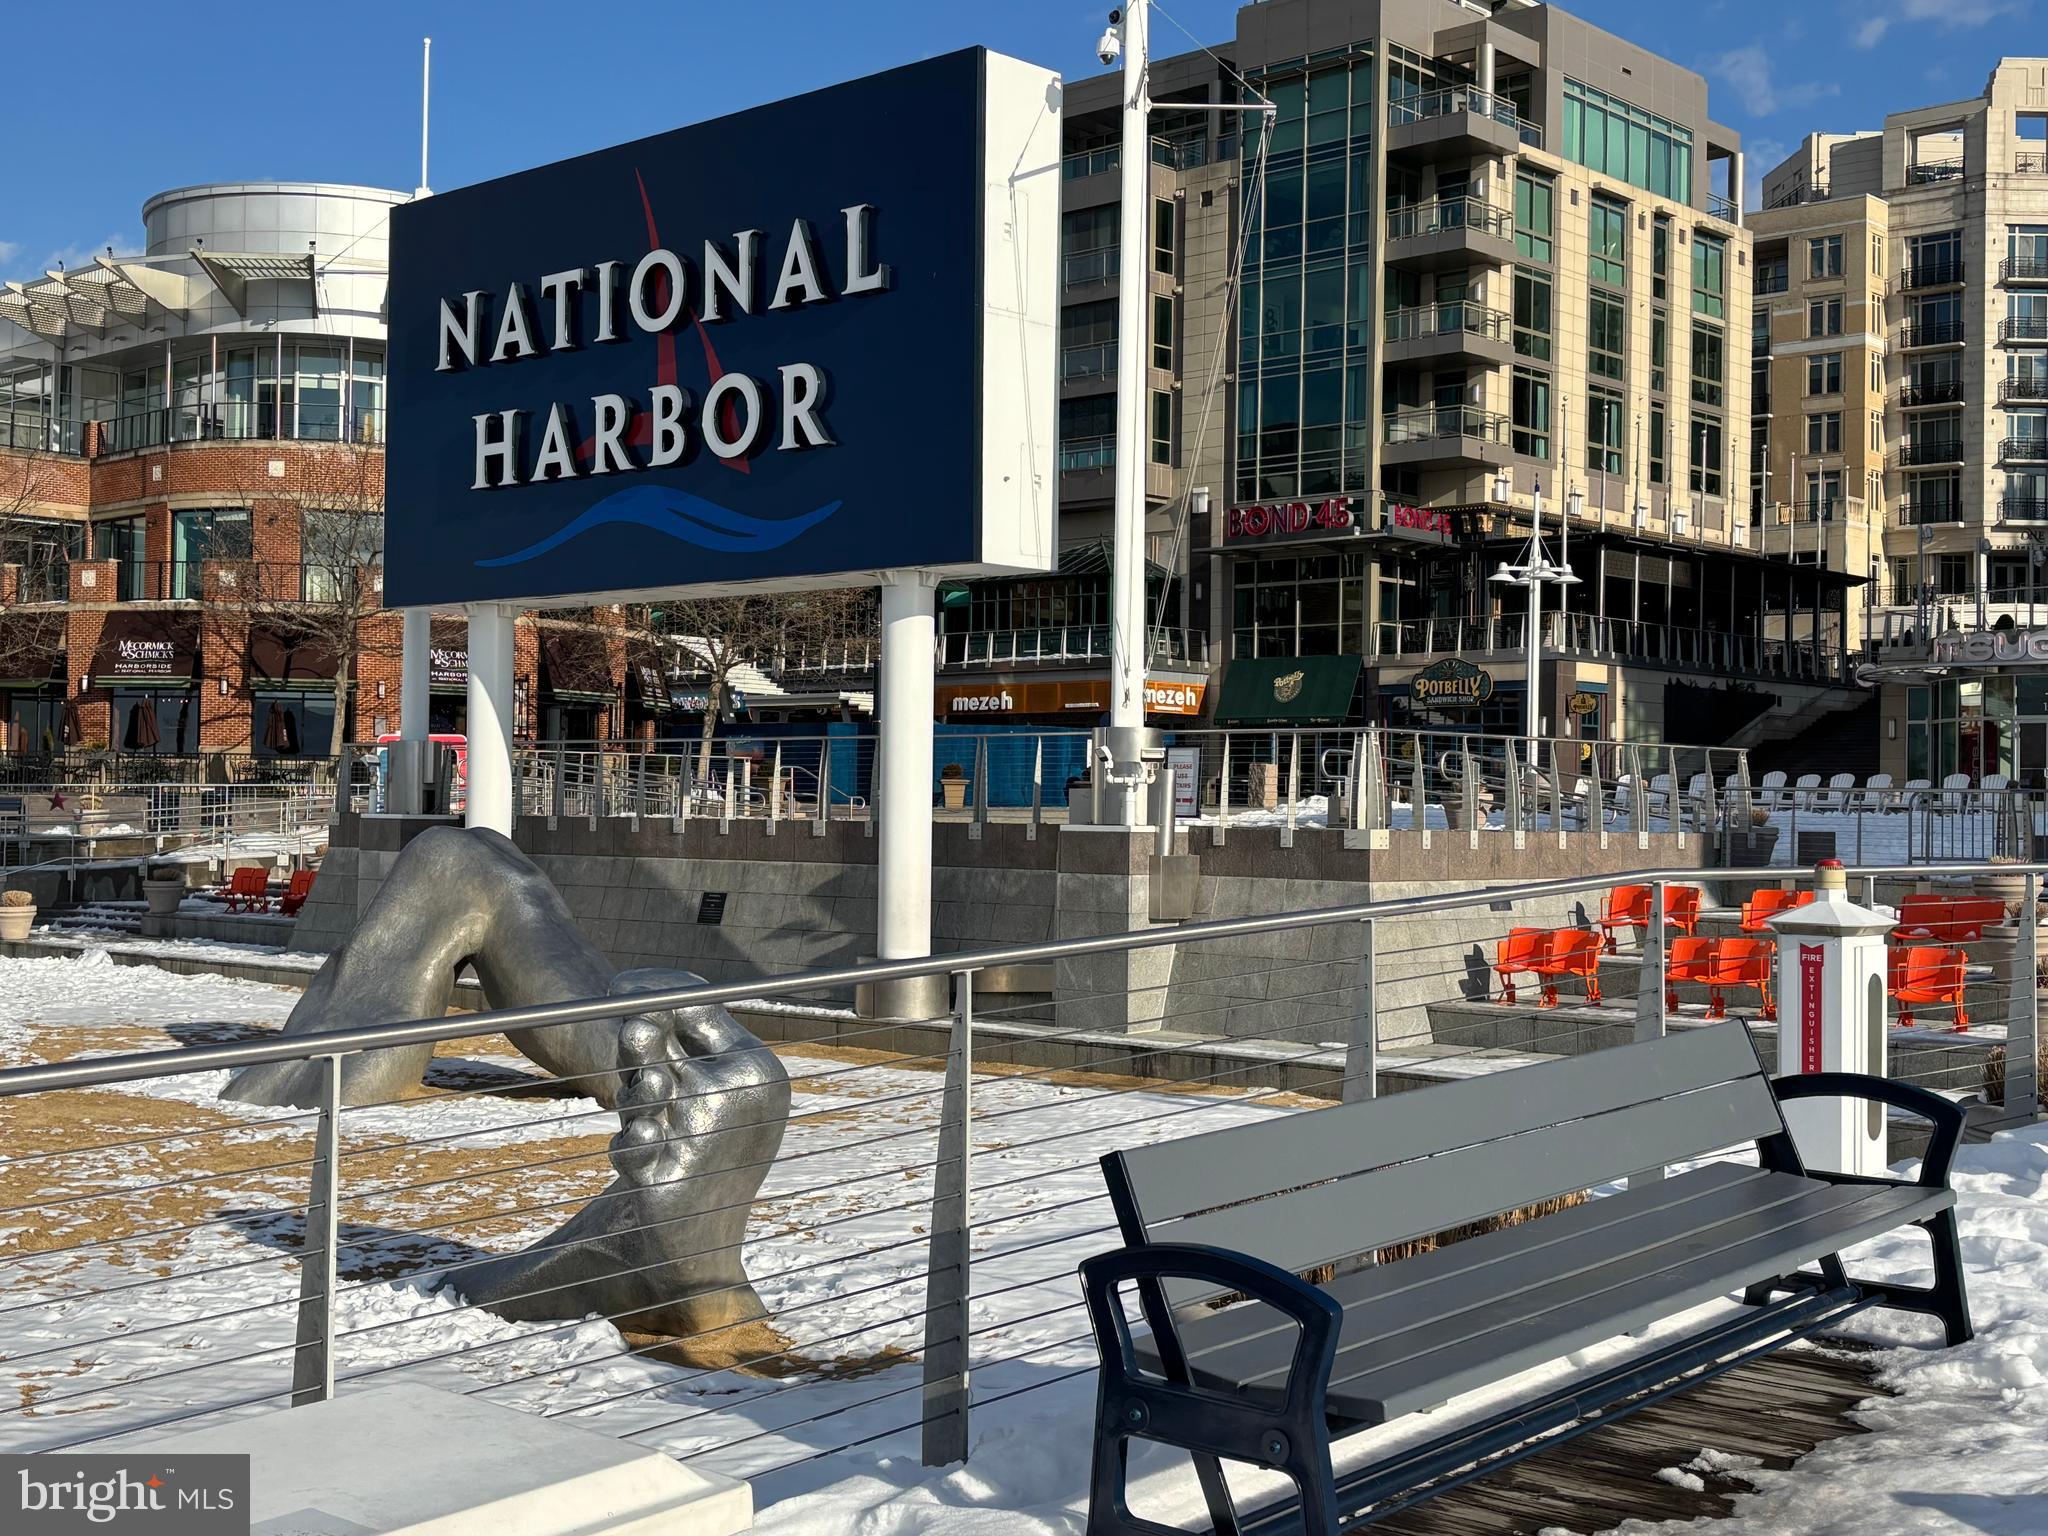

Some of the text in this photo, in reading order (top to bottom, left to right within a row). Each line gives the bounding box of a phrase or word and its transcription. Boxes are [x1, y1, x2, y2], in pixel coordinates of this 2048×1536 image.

[434, 203, 891, 372] NATIONAL
[471, 362, 837, 490] HARBOR
[1228, 497, 1355, 537] BOND 45
[952, 691, 1012, 712] mezeh
[1145, 686, 1196, 706] mezeh
[1414, 674, 1483, 700] POTBELLY
[1802, 953, 1822, 962] FIRE
[1808, 966, 1816, 1071] EXTINGUISHER
